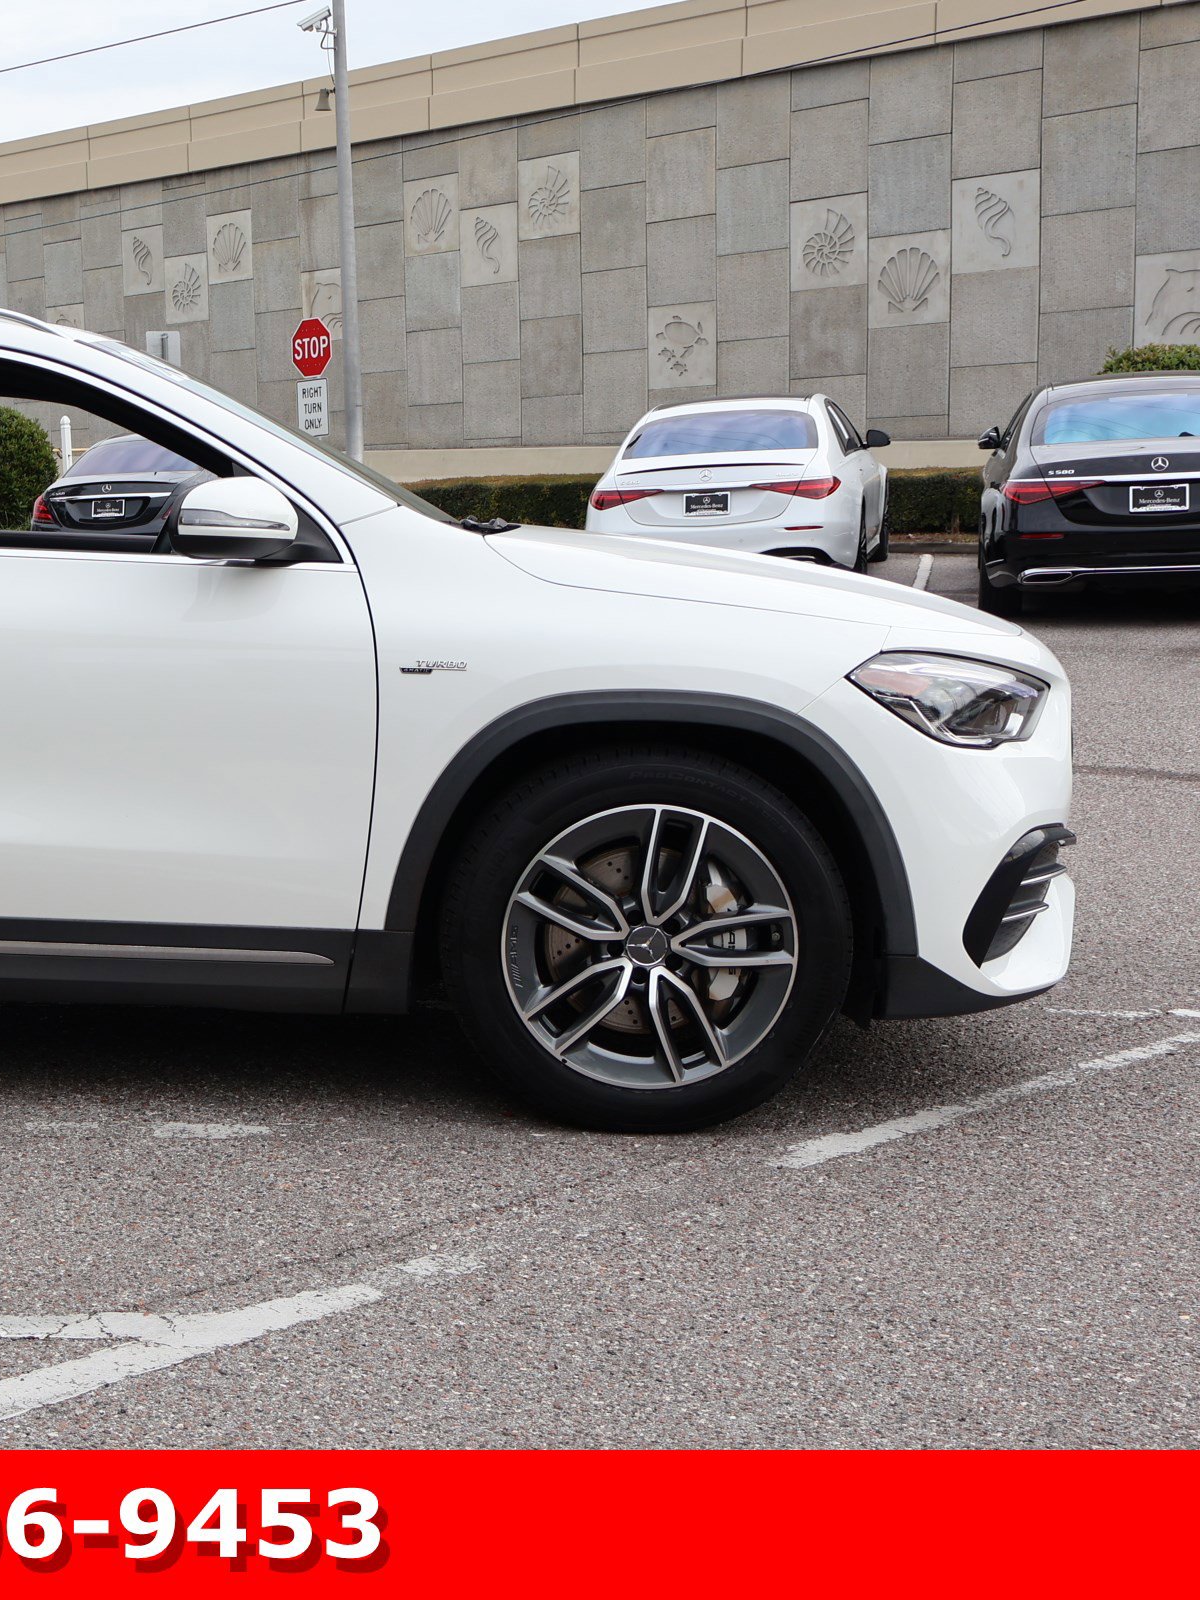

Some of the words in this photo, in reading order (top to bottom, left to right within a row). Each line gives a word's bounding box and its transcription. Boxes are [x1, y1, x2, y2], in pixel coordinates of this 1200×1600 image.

[294, 335, 329, 360] STOP
[302, 386, 323, 399] RIGHT
[304, 402, 322, 414] TURN
[304, 418, 322, 430] ONLY
[415, 660, 468, 669] TURBO
